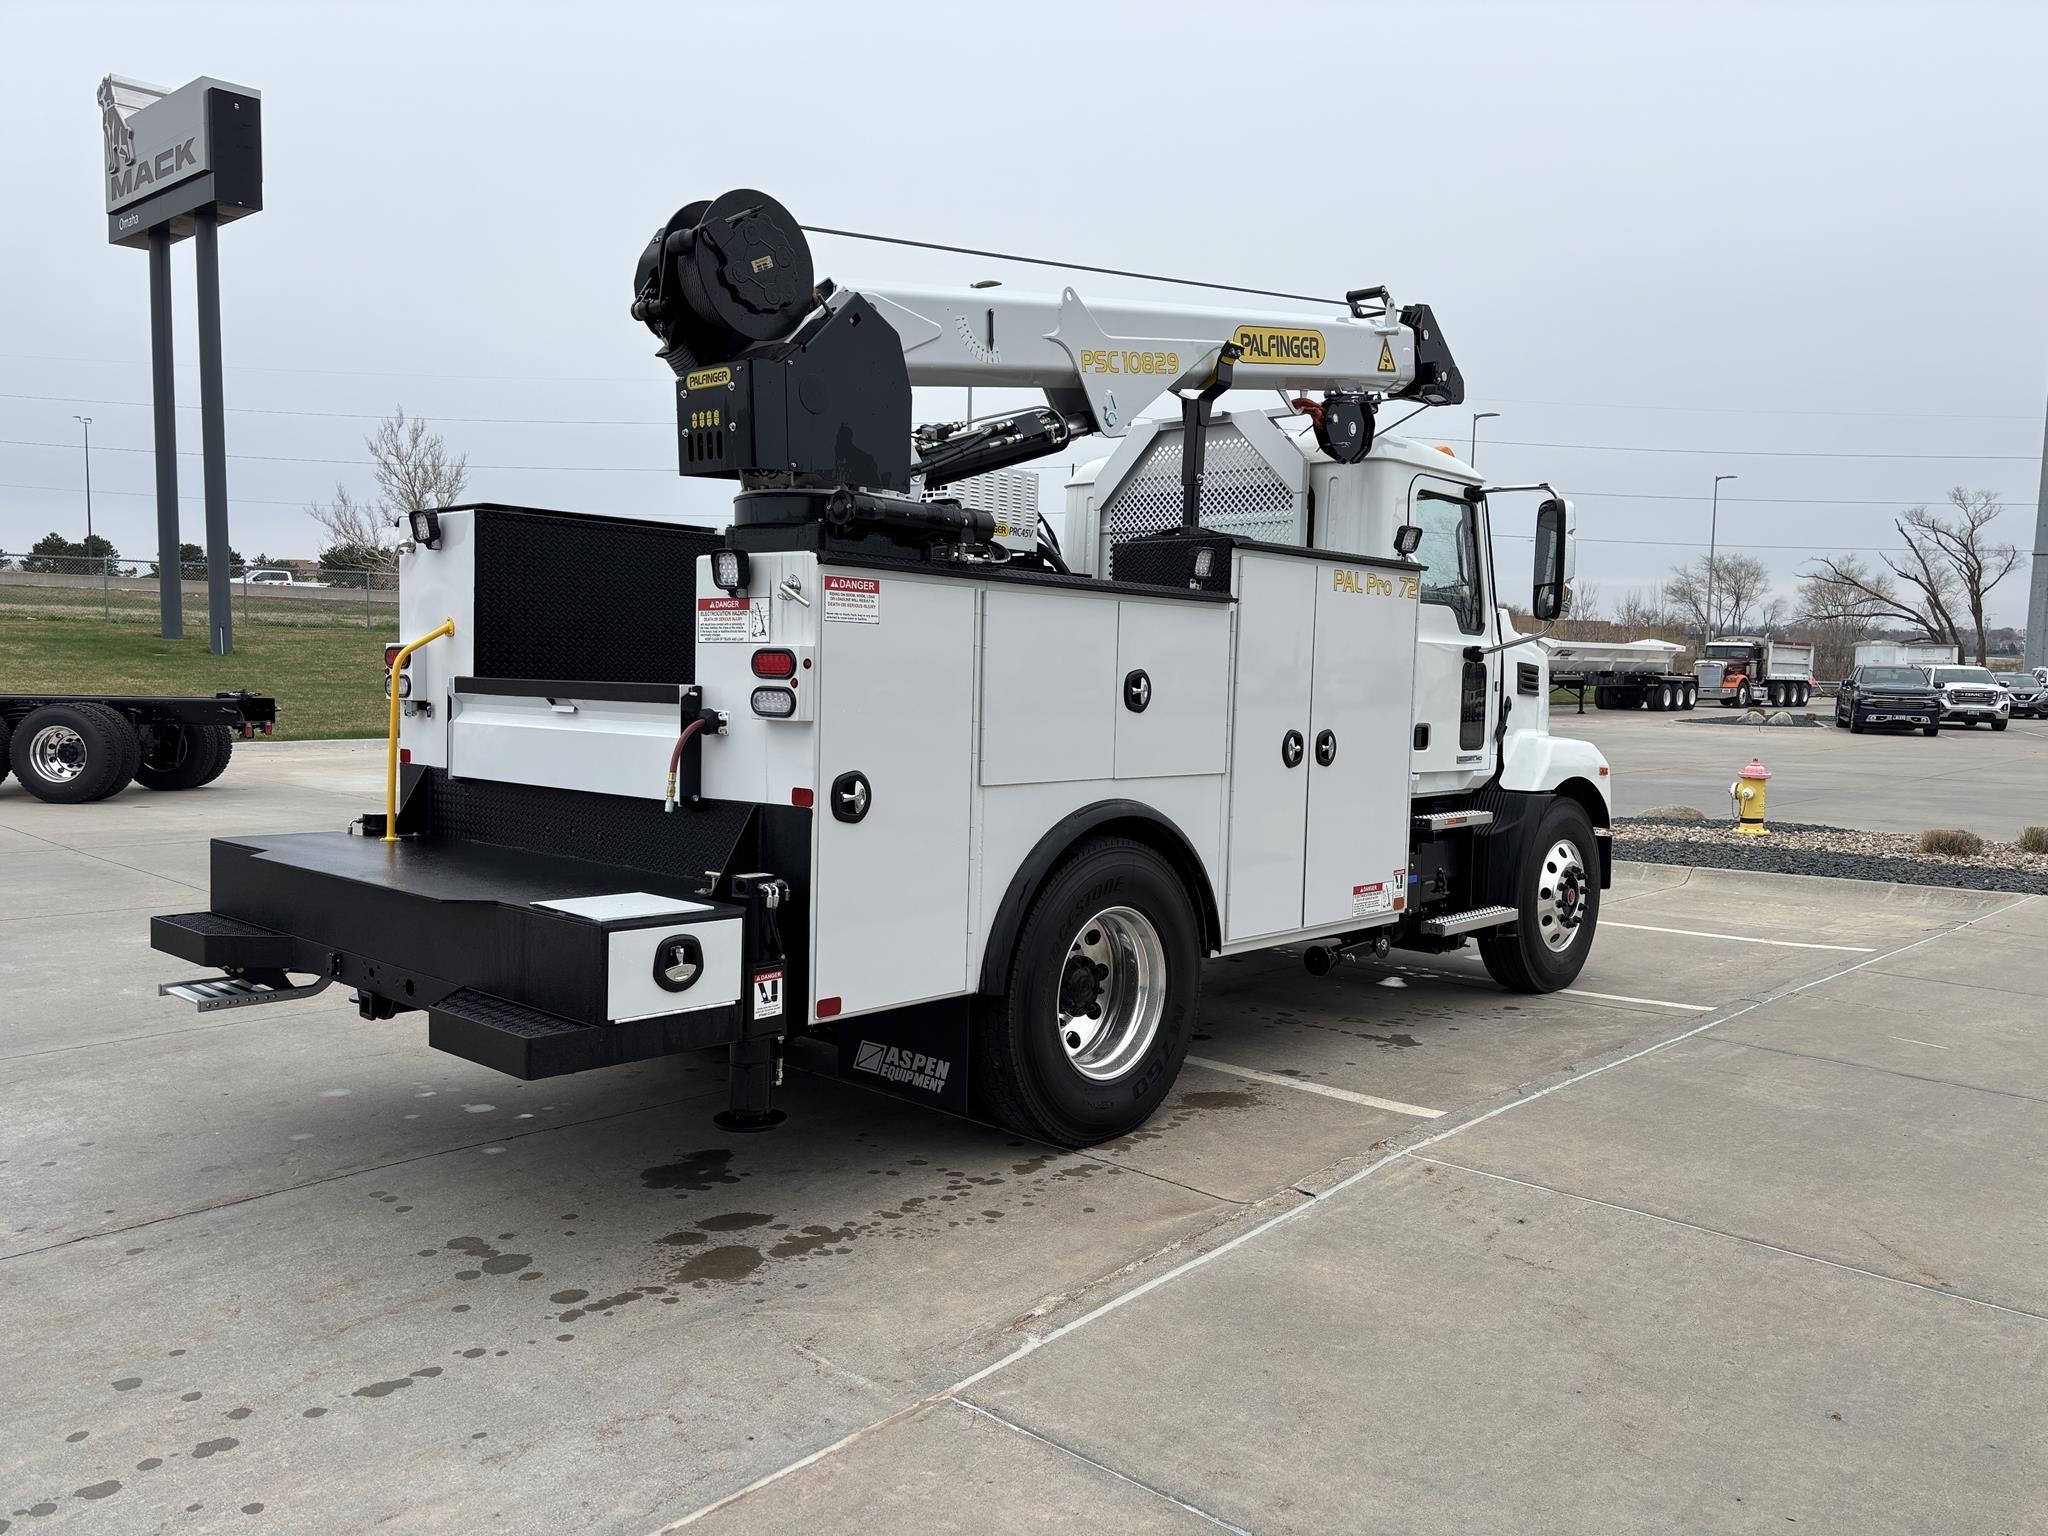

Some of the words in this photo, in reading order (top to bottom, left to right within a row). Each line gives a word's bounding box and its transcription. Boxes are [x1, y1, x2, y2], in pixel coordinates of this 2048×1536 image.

[111, 136, 197, 201] MACK
[119, 213, 139, 231] Omaha
[1240, 333, 1320, 358] PALFINGER
[689, 370, 728, 388] PALFINGER
[1009, 526, 1034, 538] PRC45V
[840, 579, 875, 590] DANGER
[1333, 569, 1363, 594] PAL
[1367, 573, 1392, 596] Pro
[1399, 576, 1418, 599] 72
[715, 600, 739, 608] DANGER
[760, 971, 782, 981] DANGER
[884, 1046, 951, 1080] ASPEN
[880, 1063, 946, 1094] EQUIPMENT
